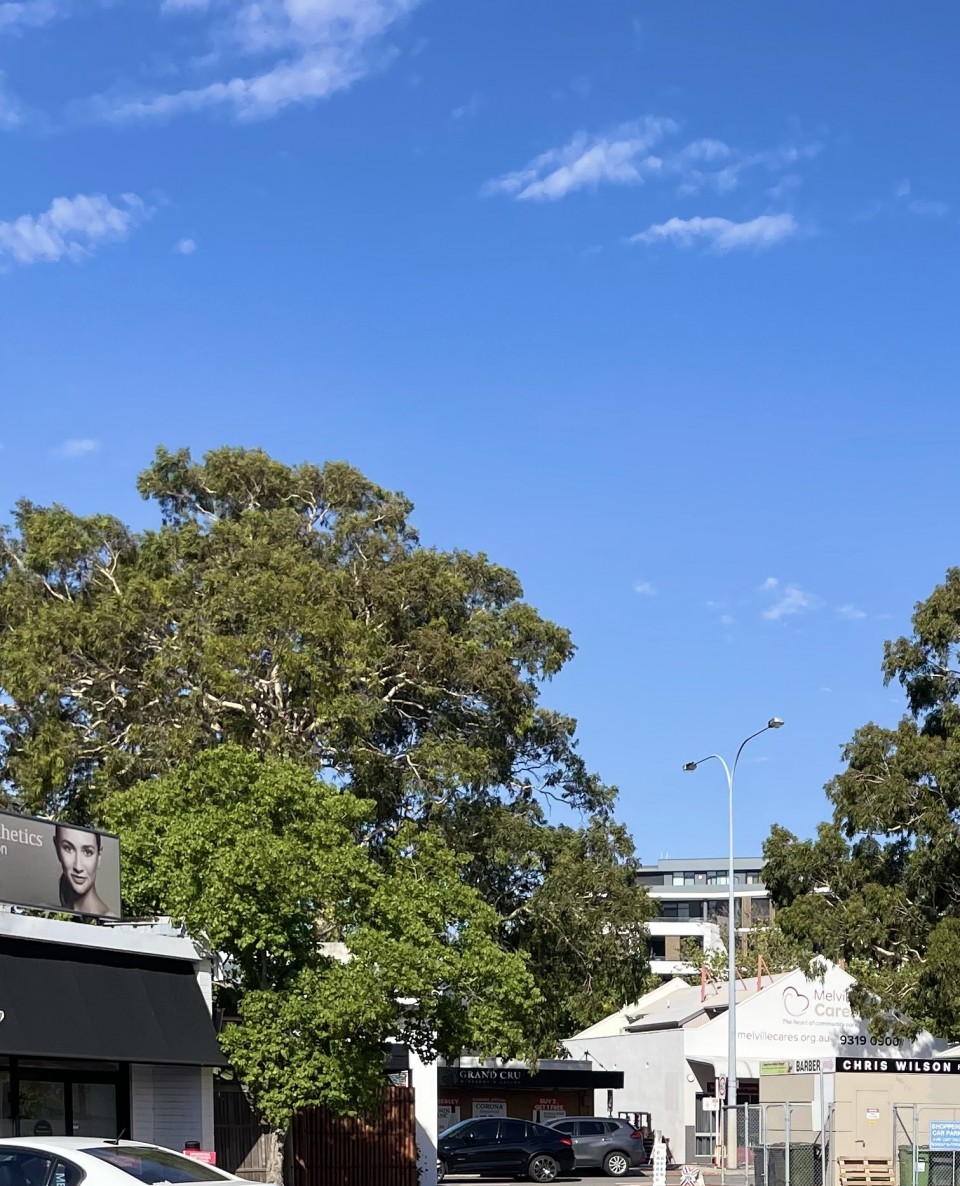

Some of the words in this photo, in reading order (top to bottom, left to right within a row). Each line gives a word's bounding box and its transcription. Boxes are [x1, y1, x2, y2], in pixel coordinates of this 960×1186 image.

[0, 823, 43, 847] hetics
[737, 1031, 830, 1044] melvillecares.org.au
[840, 1035, 867, 1046] 9319
[870, 1036, 900, 1047] 0900
[796, 1059, 821, 1072] BARBER
[843, 1060, 888, 1071] CHRIS
[896, 1060, 951, 1072] WILSON
[459, 1070, 498, 1080] GRAND
[499, 1071, 521, 1080] CRU
